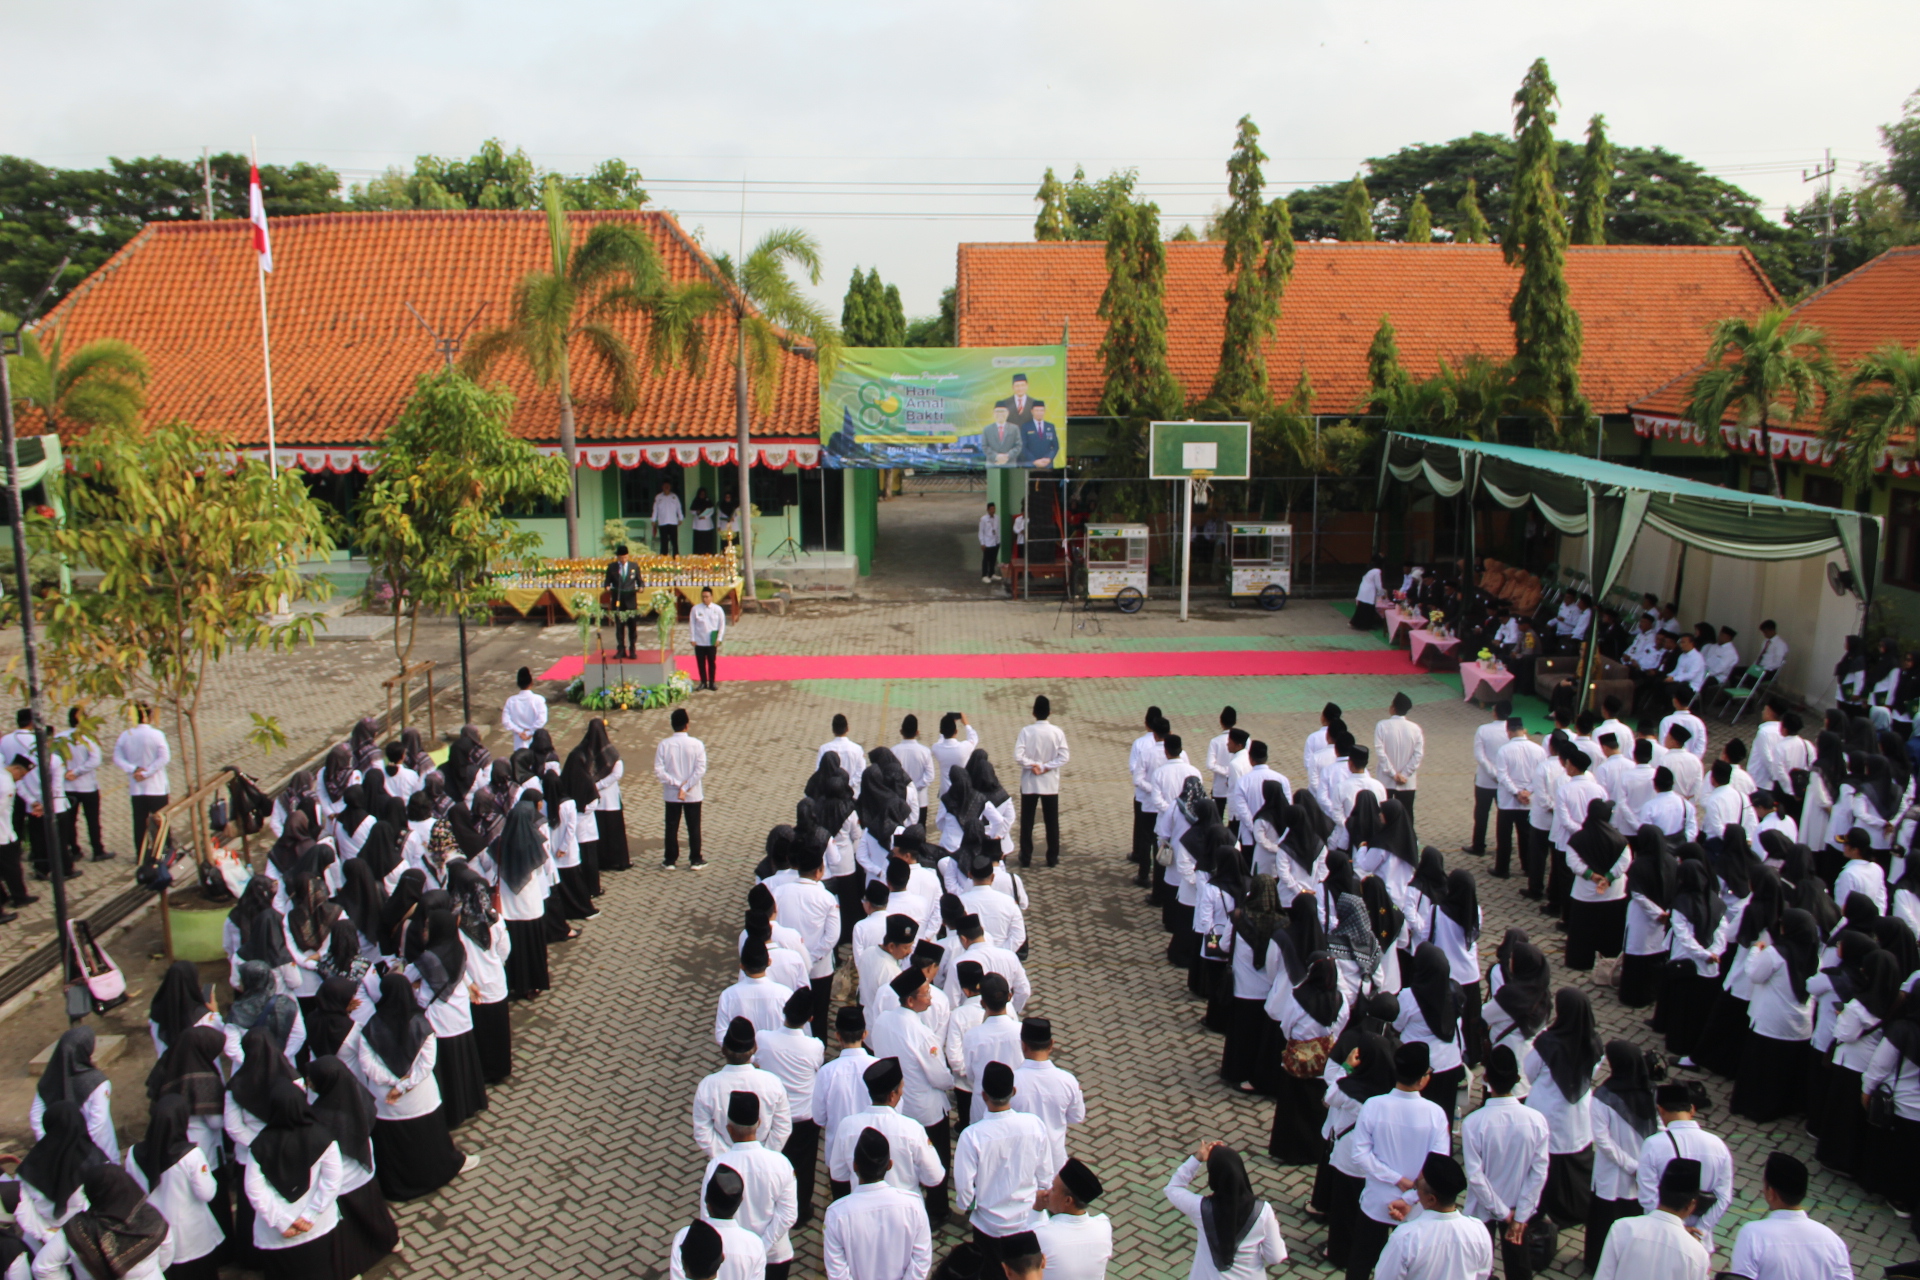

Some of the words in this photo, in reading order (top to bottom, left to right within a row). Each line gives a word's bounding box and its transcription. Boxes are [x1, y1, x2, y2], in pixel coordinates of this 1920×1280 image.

[906, 384, 935, 396] Hari
[906, 397, 943, 408] Amal
[906, 409, 943, 421] Bakti
